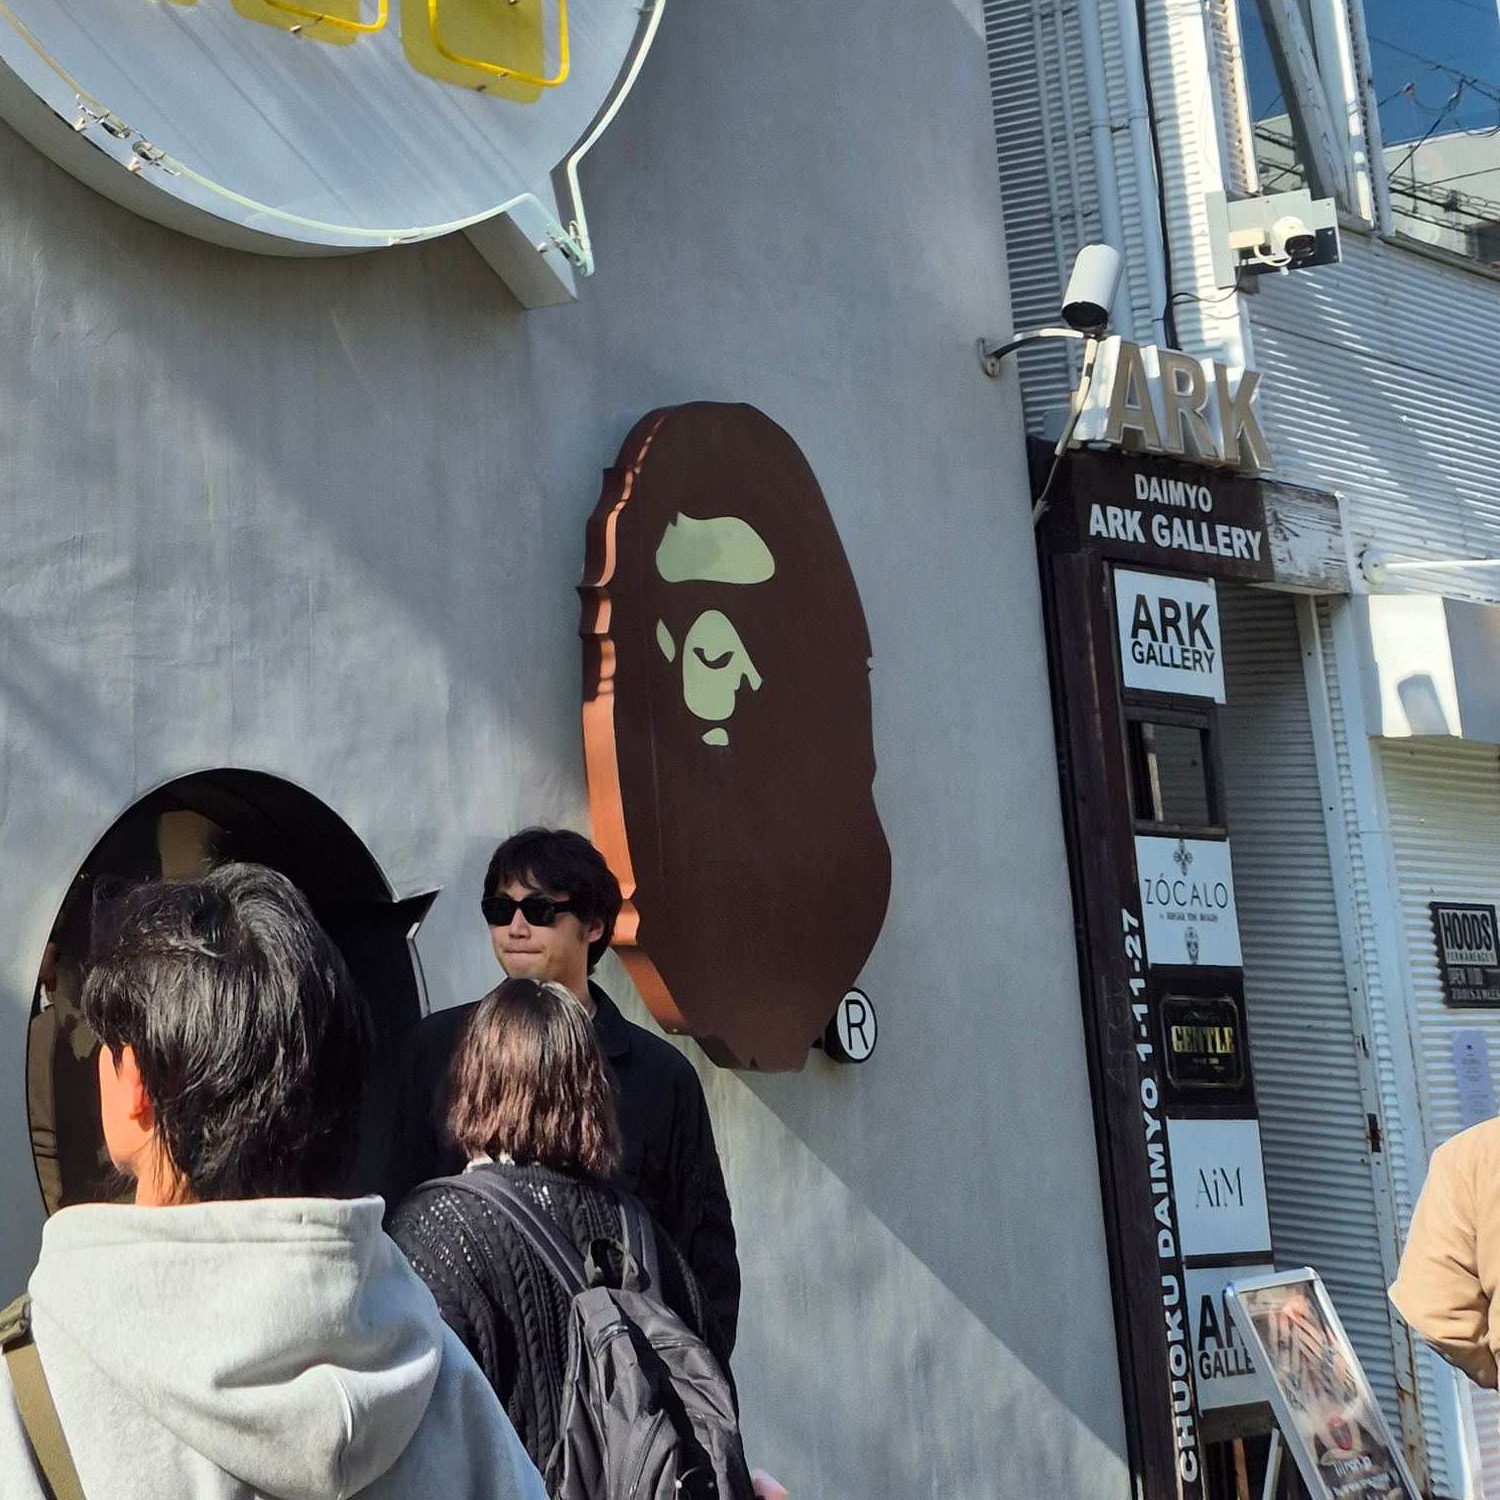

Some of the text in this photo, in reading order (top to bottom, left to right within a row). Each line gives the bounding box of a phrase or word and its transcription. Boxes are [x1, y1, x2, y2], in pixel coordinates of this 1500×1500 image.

[1104, 340, 1276, 474] ARK
[1134, 473, 1213, 513] DAIMYO
[1089, 503, 1262, 562] ARK GALLERY
[1130, 593, 1215, 651] ARK
[1131, 640, 1216, 674] GALLERY
[1144, 872, 1229, 909] ZÓCALO
[1440, 911, 1493, 952] HOODS
[1171, 1025, 1234, 1054] GENTLE
[1121, 908, 1198, 1483] CHUOKU DAIMYO 1-11-27
